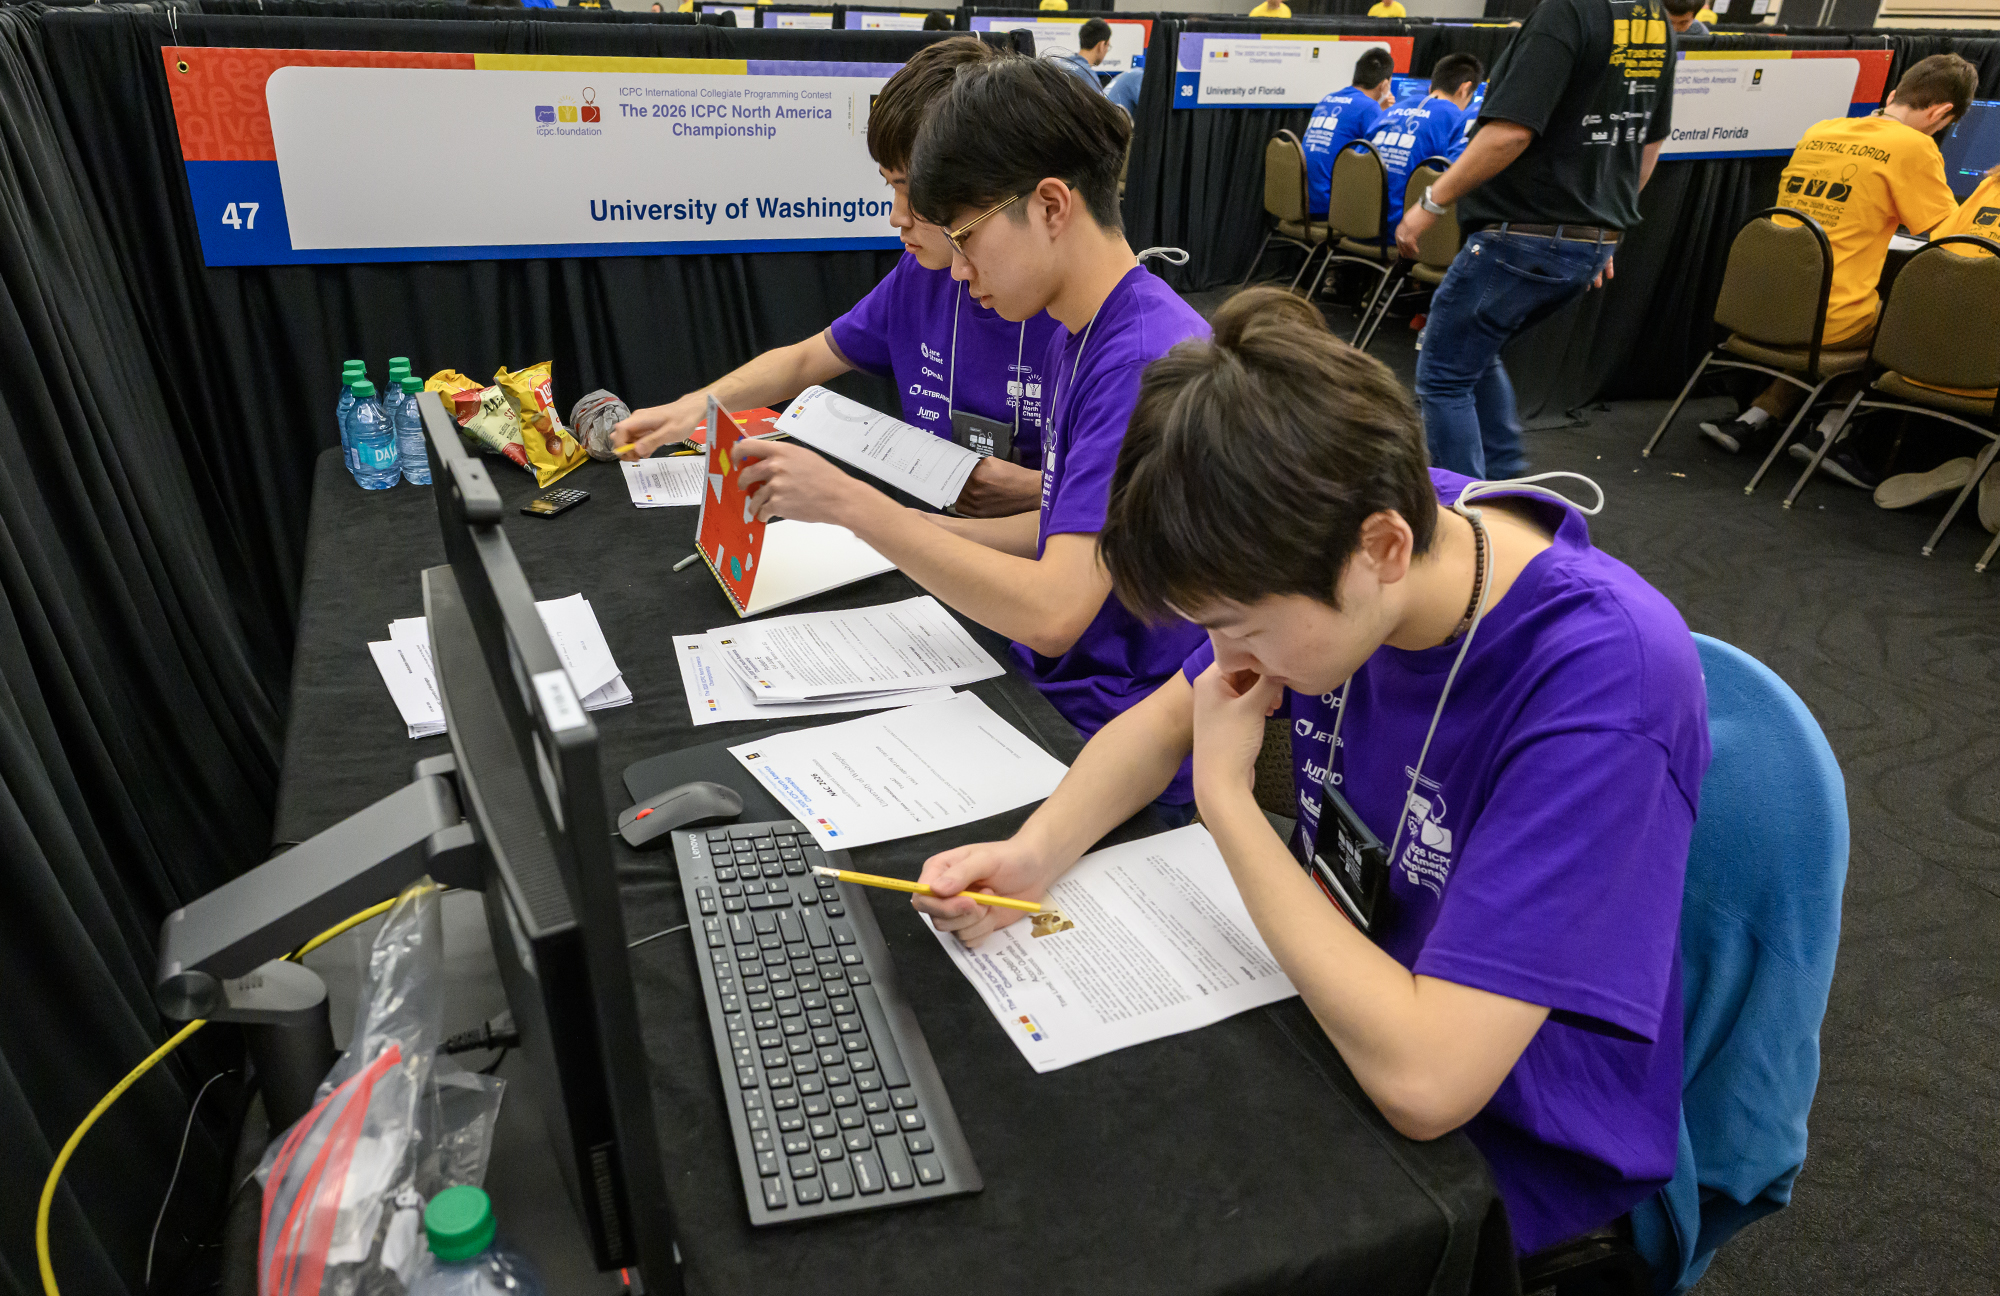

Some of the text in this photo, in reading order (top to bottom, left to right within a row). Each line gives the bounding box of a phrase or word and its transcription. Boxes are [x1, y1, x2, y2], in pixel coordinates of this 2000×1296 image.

[1675, 76, 1691, 84] ICPC
[619, 87, 832, 101] ICPC International Collegiate Programming Contest
[1206, 86, 1285, 96] University of Florida
[1673, 87, 1710, 95] mpionship
[619, 104, 647, 118] The
[652, 104, 687, 118] 2026
[691, 104, 727, 119] ICPC
[732, 105, 771, 119] North
[775, 106, 832, 119] America
[536, 126, 602, 137] icpc.foundation
[672, 122, 777, 139] Championship
[1672, 127, 1749, 140] Central Florida
[1806, 140, 1891, 164] CENTRAL FLORIDA
[221, 202, 260, 230] 47
[590, 196, 893, 225] University of Washington
[1811, 209, 1840, 220] America
[1825, 203, 1844, 214] ICPC
[929, 349, 940, 357] Jane
[930, 354, 943, 364] Street
[917, 407, 940, 421] Jump
[826, 751, 863, 778] Washington
[1302, 759, 1343, 785] Jump
[761, 765, 781, 780] America
[775, 779, 791, 790] North
[782, 776, 814, 802] Championship
[808, 772, 839, 797] NAC 2026
[786, 789, 801, 799] ICPC
[858, 783, 892, 807] University
[803, 807, 816, 815] The
[686, 833, 701, 859] Lenovo
[1010, 939, 1029, 957] Memory
[972, 956, 989, 971] North
[979, 952, 1013, 989] Championship
[1000, 955, 1027, 982] Problem
[1003, 944, 1040, 983] Acorn Quarrels
[983, 969, 999, 984] ICPC
[1238, 964, 1257, 981] Output
[1195, 982, 1210, 996] Input
[1003, 998, 1018, 1010] The
[1054, 993, 1068, 1007] Time
